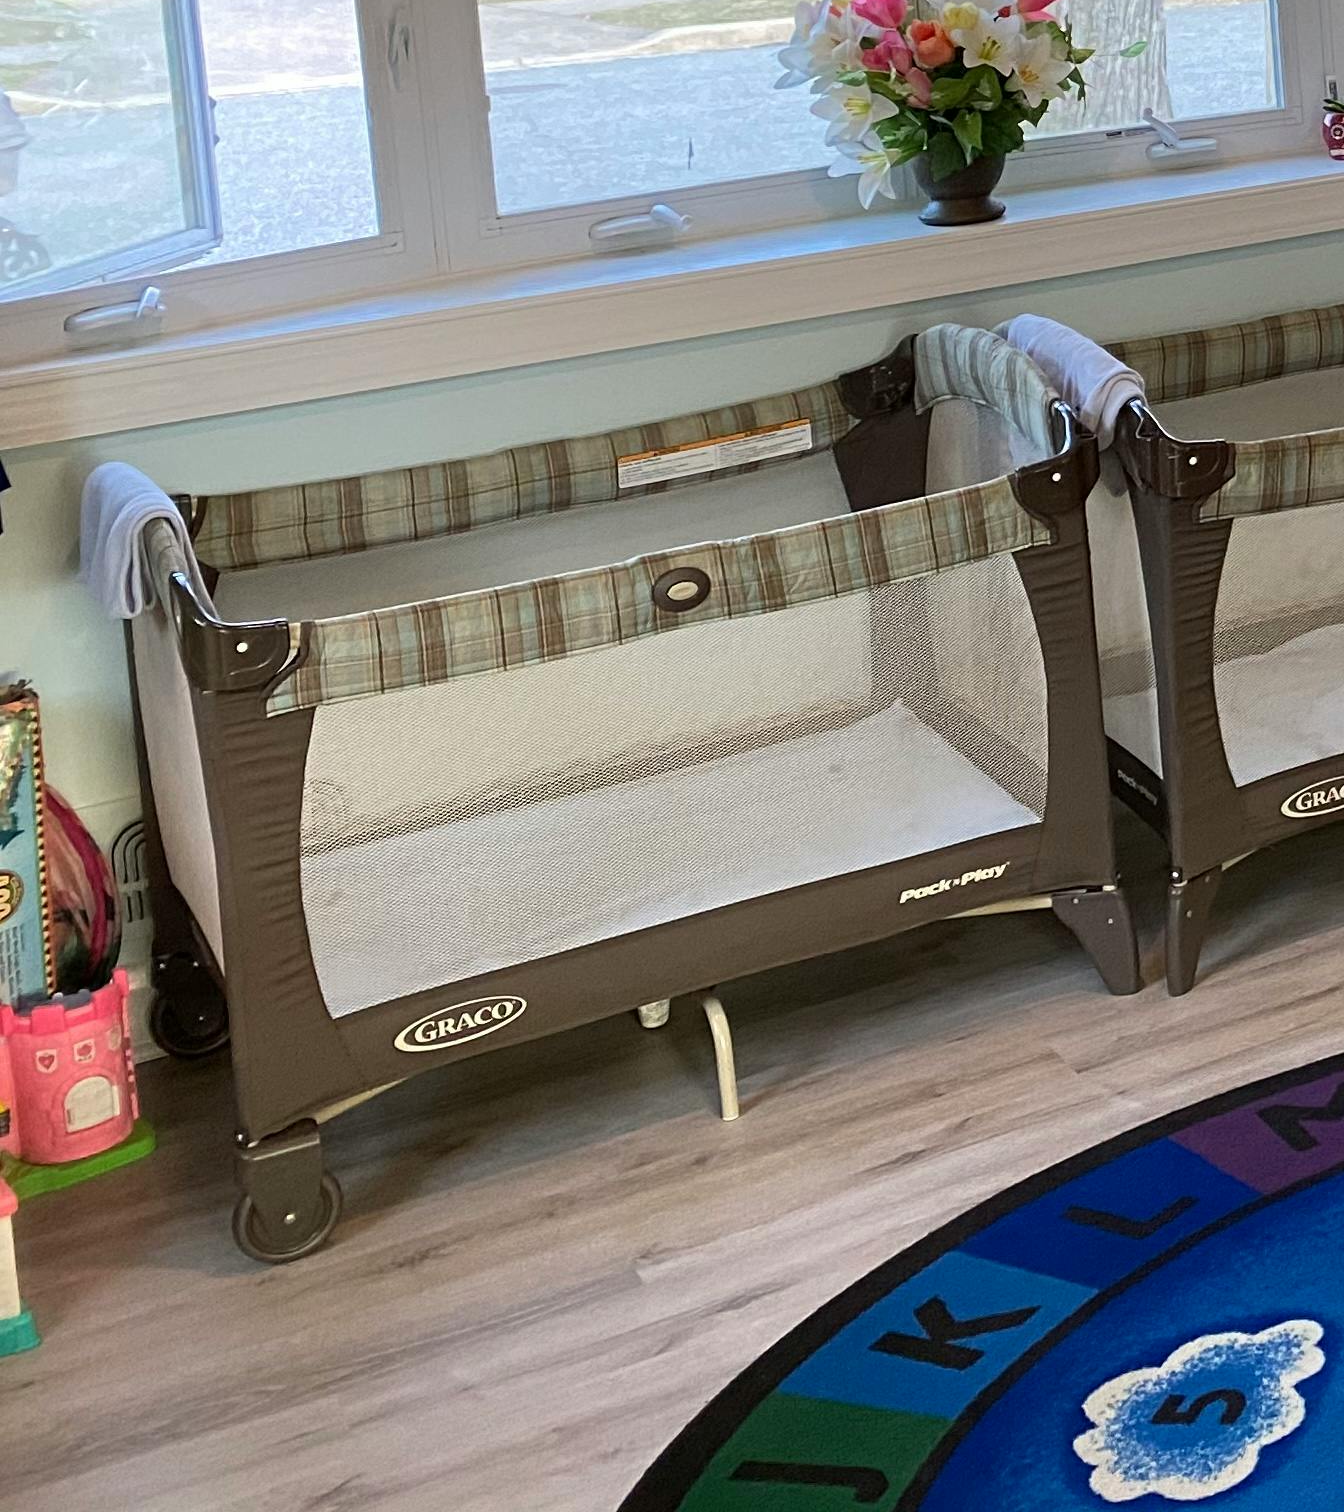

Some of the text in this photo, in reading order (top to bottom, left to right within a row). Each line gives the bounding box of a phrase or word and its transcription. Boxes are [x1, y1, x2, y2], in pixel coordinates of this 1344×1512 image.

[899, 879, 952, 904] Pack
[961, 863, 1007, 886] Play
[414, 1001, 514, 1043] GRACO
[1061, 1194, 1196, 1241] L
[867, 1292, 1045, 1374] K
[1152, 1387, 1247, 1428] 5
[728, 1461, 890, 1503] J
